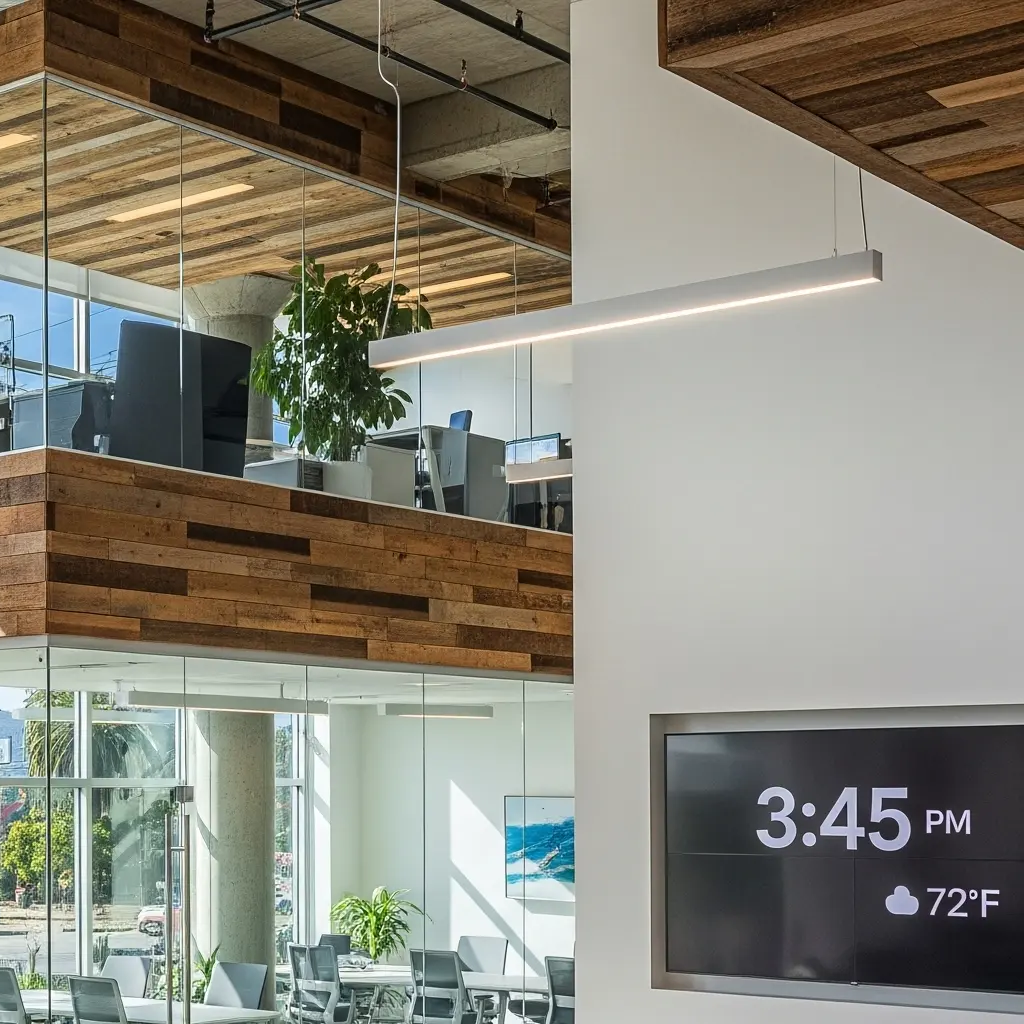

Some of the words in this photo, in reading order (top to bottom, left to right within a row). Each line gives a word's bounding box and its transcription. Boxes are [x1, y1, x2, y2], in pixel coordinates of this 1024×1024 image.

[756, 786, 912, 852] 3:45
[926, 809, 971, 835] PM
[926, 886, 1000, 918] 72°F
